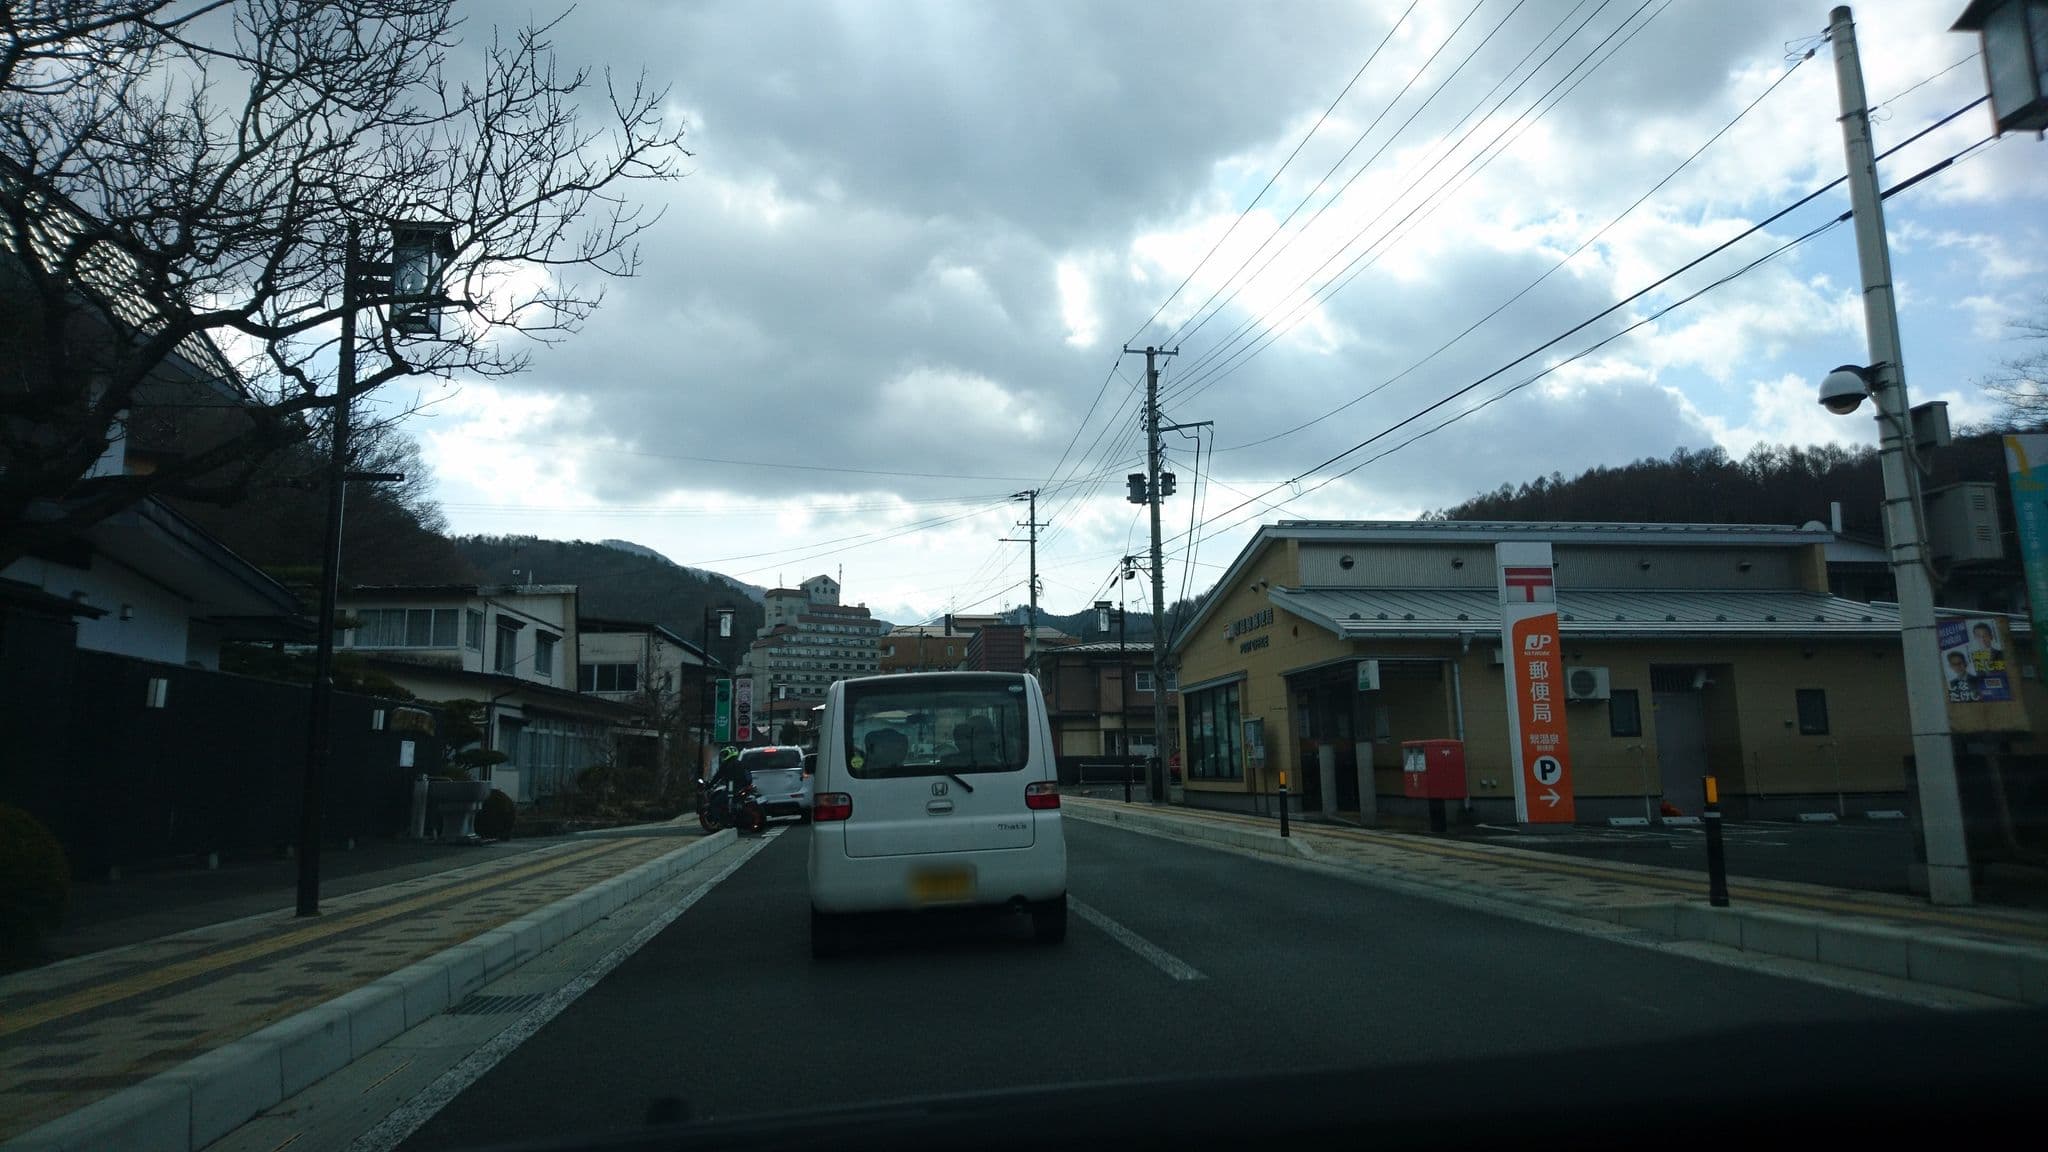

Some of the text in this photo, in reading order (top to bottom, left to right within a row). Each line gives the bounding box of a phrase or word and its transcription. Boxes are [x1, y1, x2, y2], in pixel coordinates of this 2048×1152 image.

[1525, 635, 1552, 650] JP
[1529, 660, 1552, 723] 郵便局
[1540, 760, 1555, 780] P
